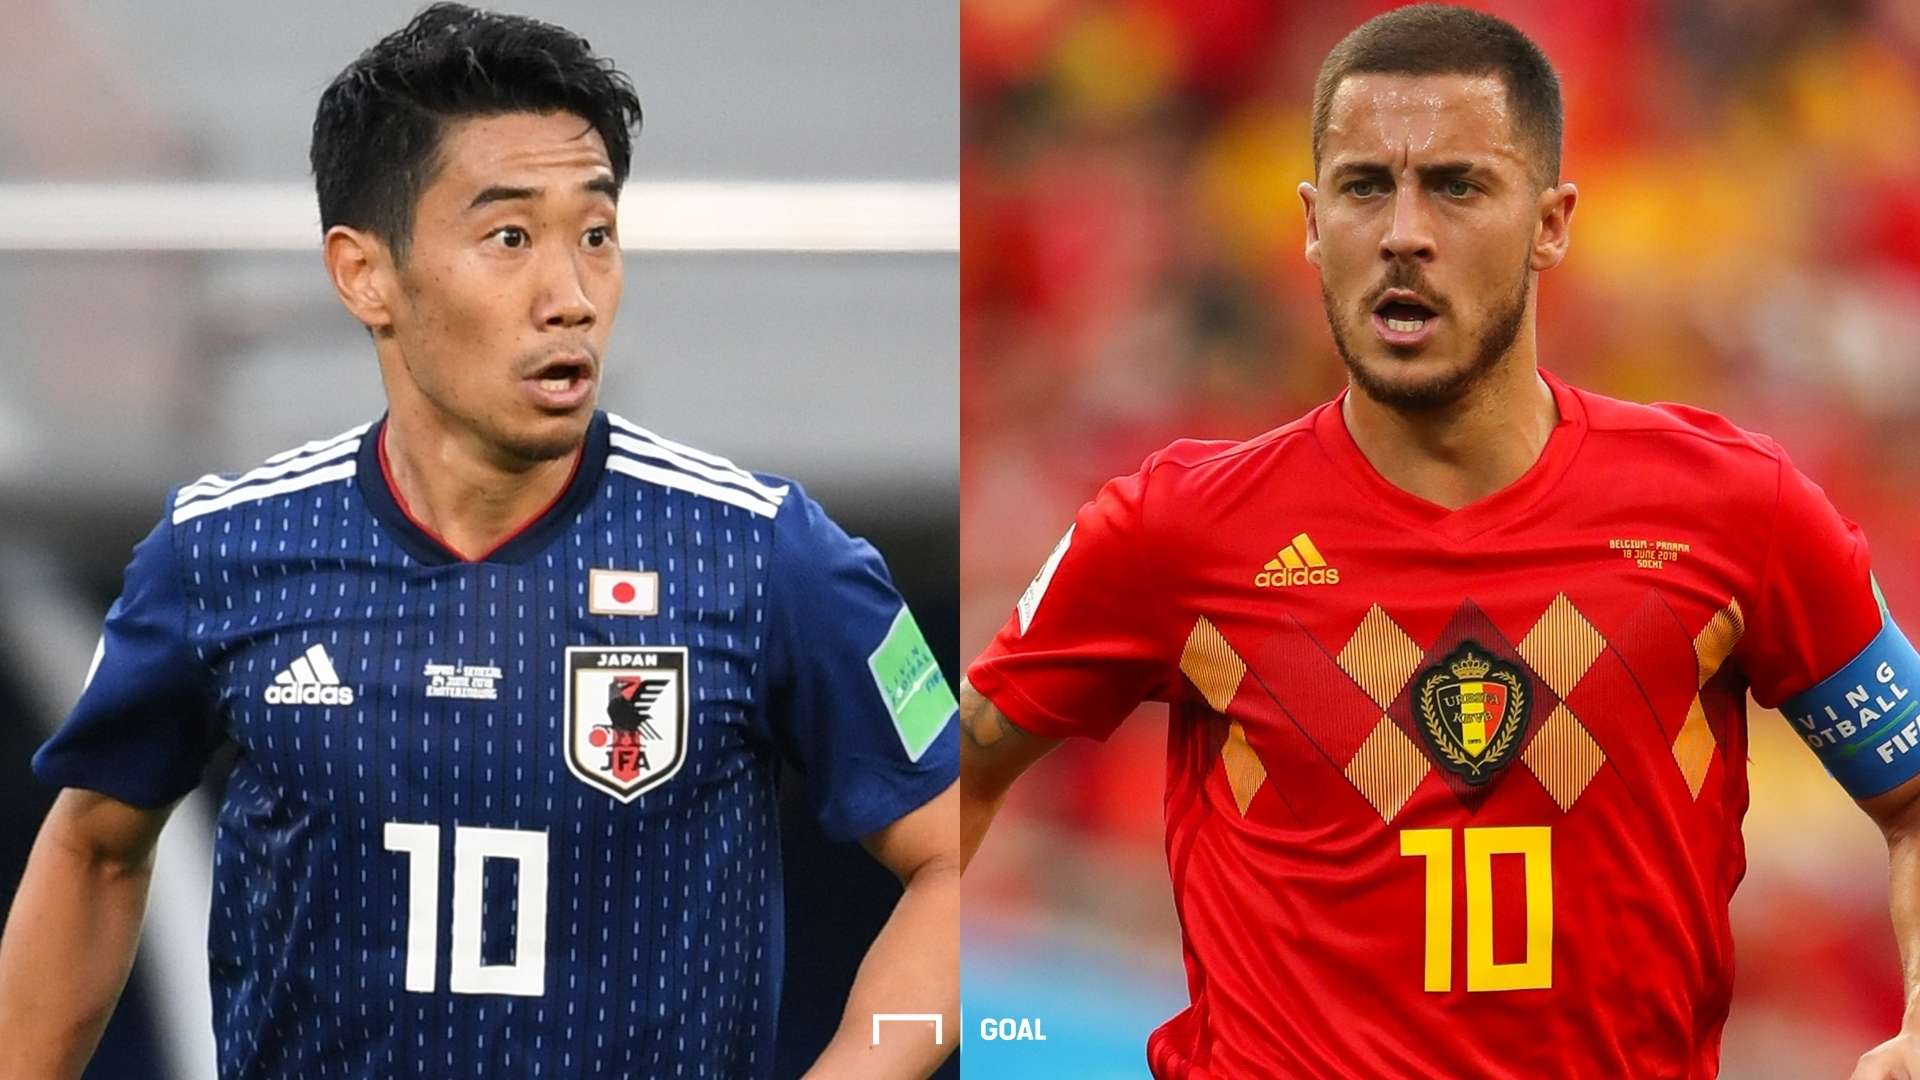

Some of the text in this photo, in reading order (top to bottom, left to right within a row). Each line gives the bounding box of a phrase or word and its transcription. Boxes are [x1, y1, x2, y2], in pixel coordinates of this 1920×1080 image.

[1609, 539, 1648, 549] BELGIUM
[1656, 541, 1690, 552] PANAMA
[1623, 550, 1678, 561] 18 JUNE 2018
[1637, 559, 1663, 569] SOCHI
[1254, 566, 1340, 588] adidas
[597, 654, 658, 667] JAPAN
[264, 683, 354, 706] adidas
[1799, 661, 1895, 731] VING
[1807, 683, 1909, 748] OTBALL
[600, 751, 651, 771] JFA
[384, 822, 549, 997] 10
[1400, 826, 1553, 992] 10
